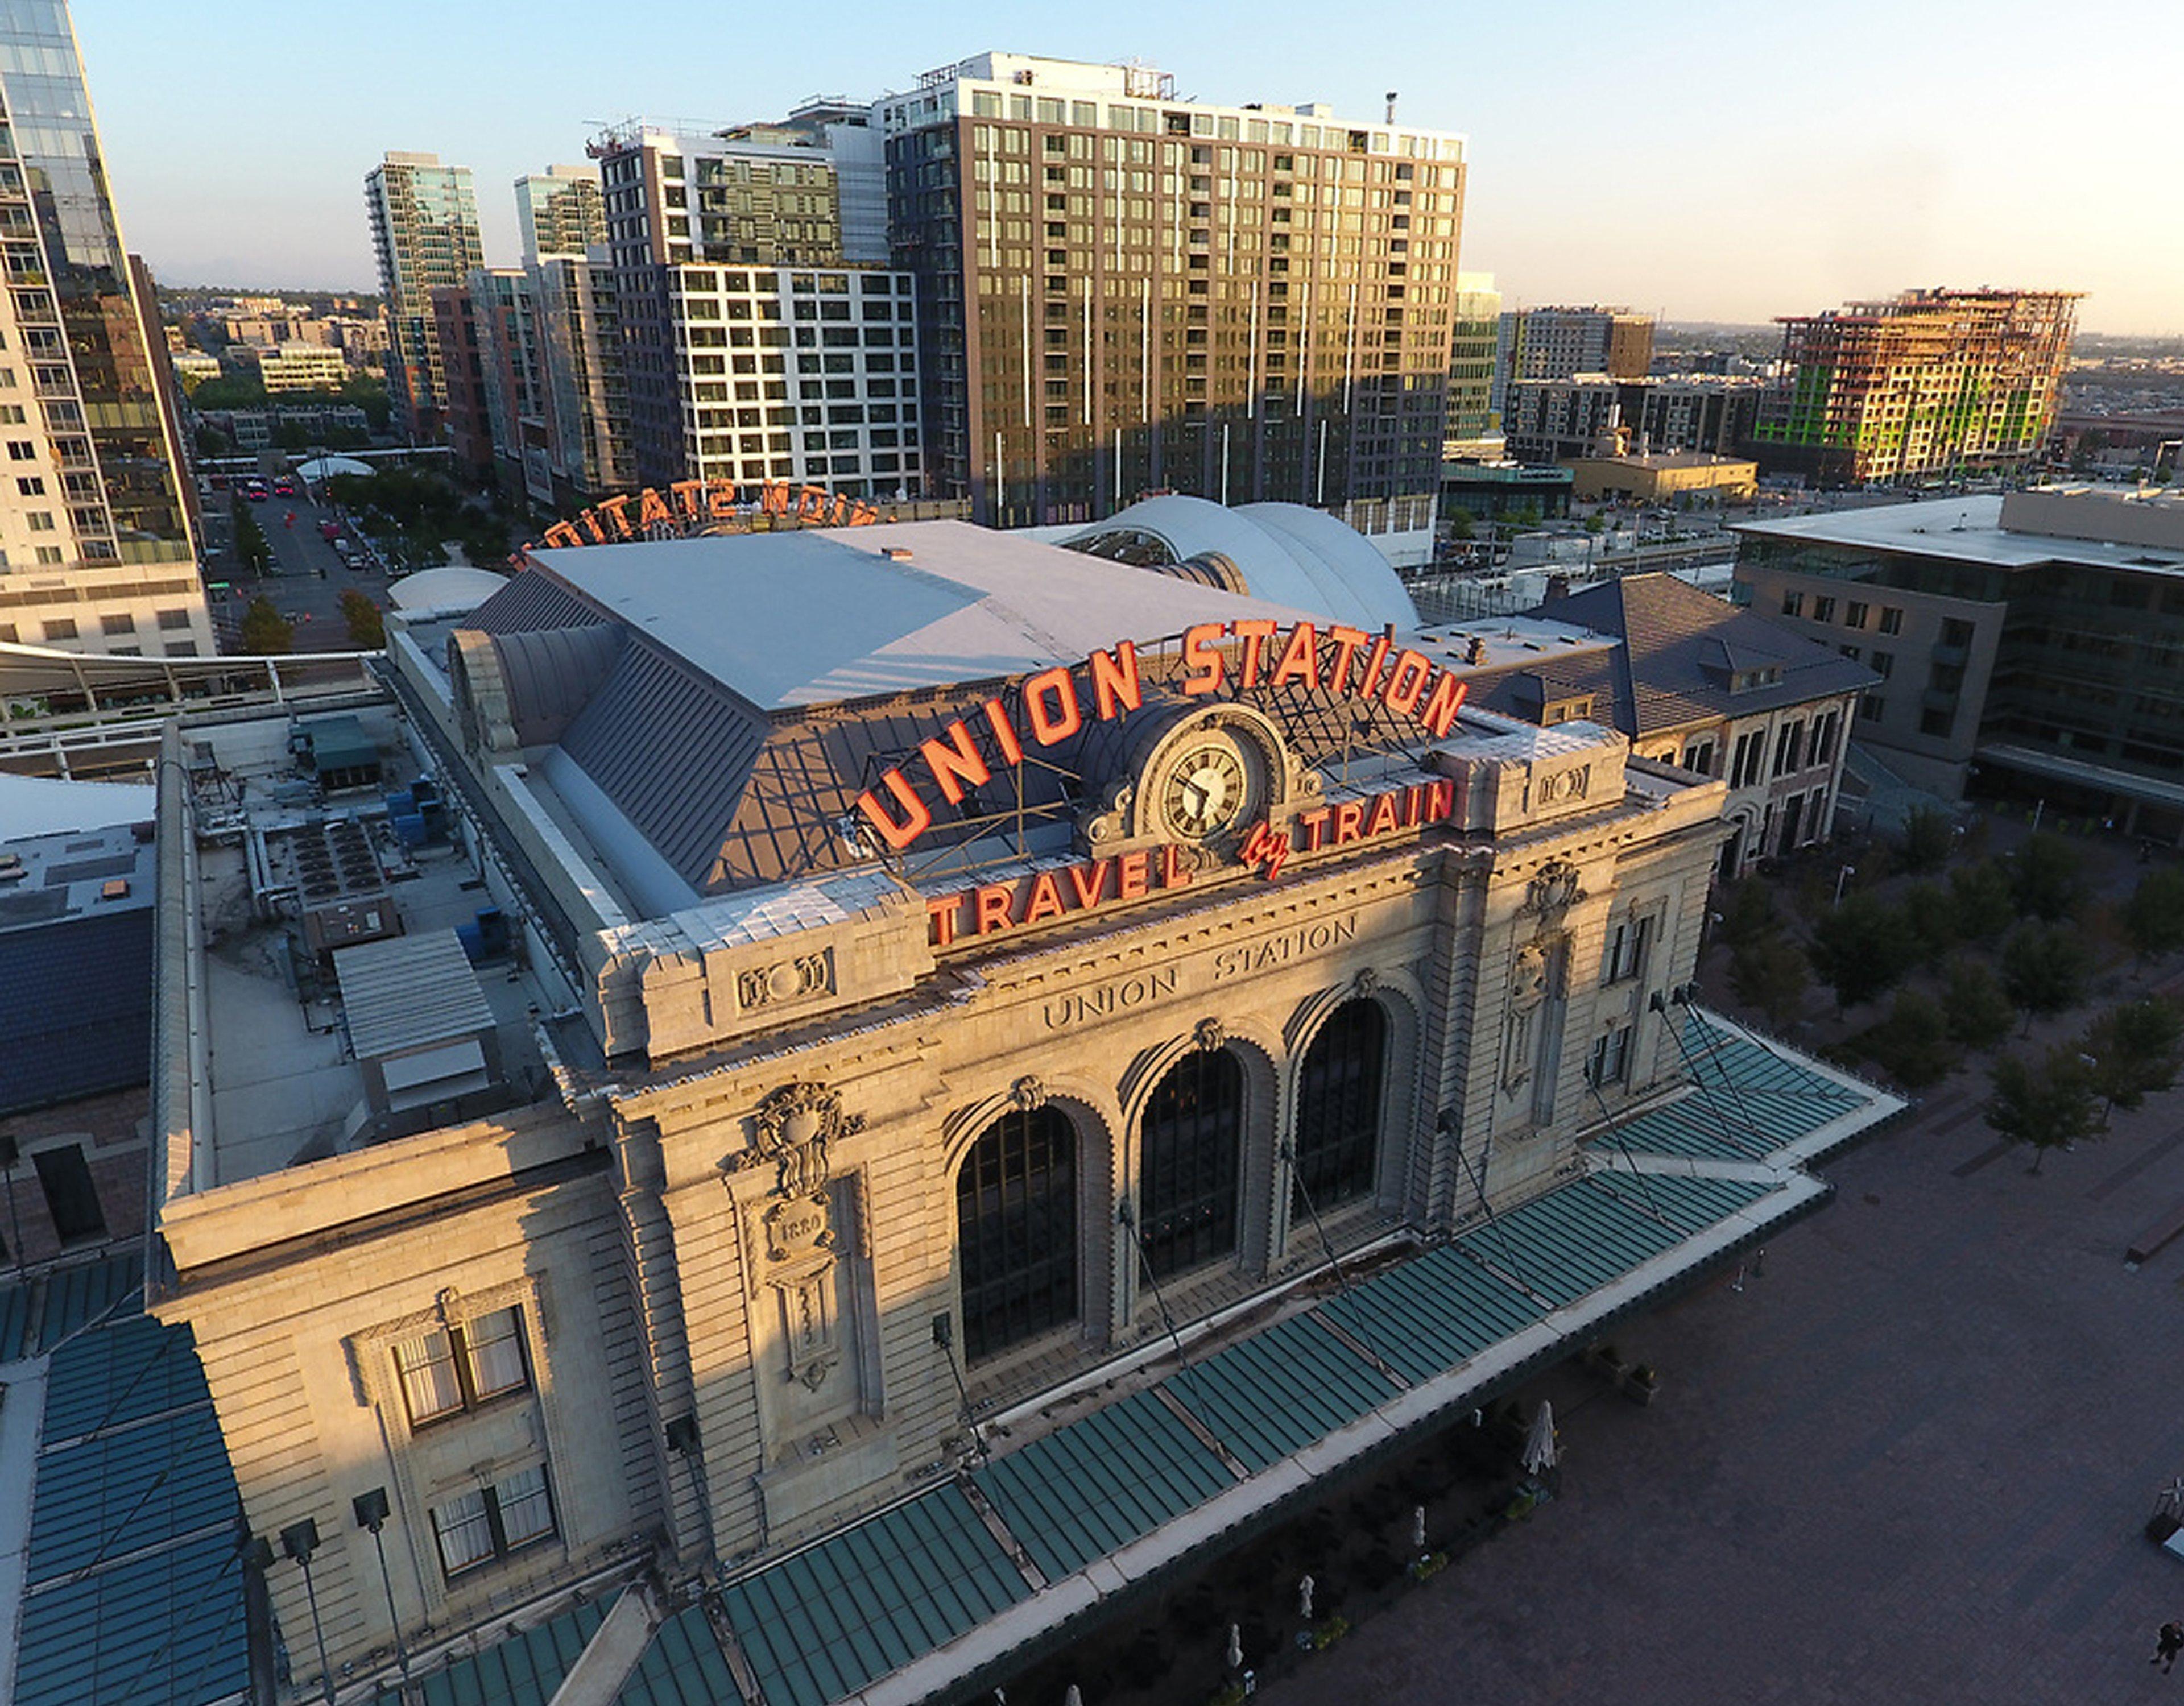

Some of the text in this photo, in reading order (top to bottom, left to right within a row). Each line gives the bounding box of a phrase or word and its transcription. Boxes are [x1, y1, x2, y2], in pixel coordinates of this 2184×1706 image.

[857, 641, 1143, 849] UNION
[1182, 620, 1467, 738] STATION
[926, 846, 1193, 945] TRAVEL
[1237, 819, 1289, 880] by
[1300, 779, 1454, 851] TRAIN
[1043, 915, 1356, 1028] UNION STATION
